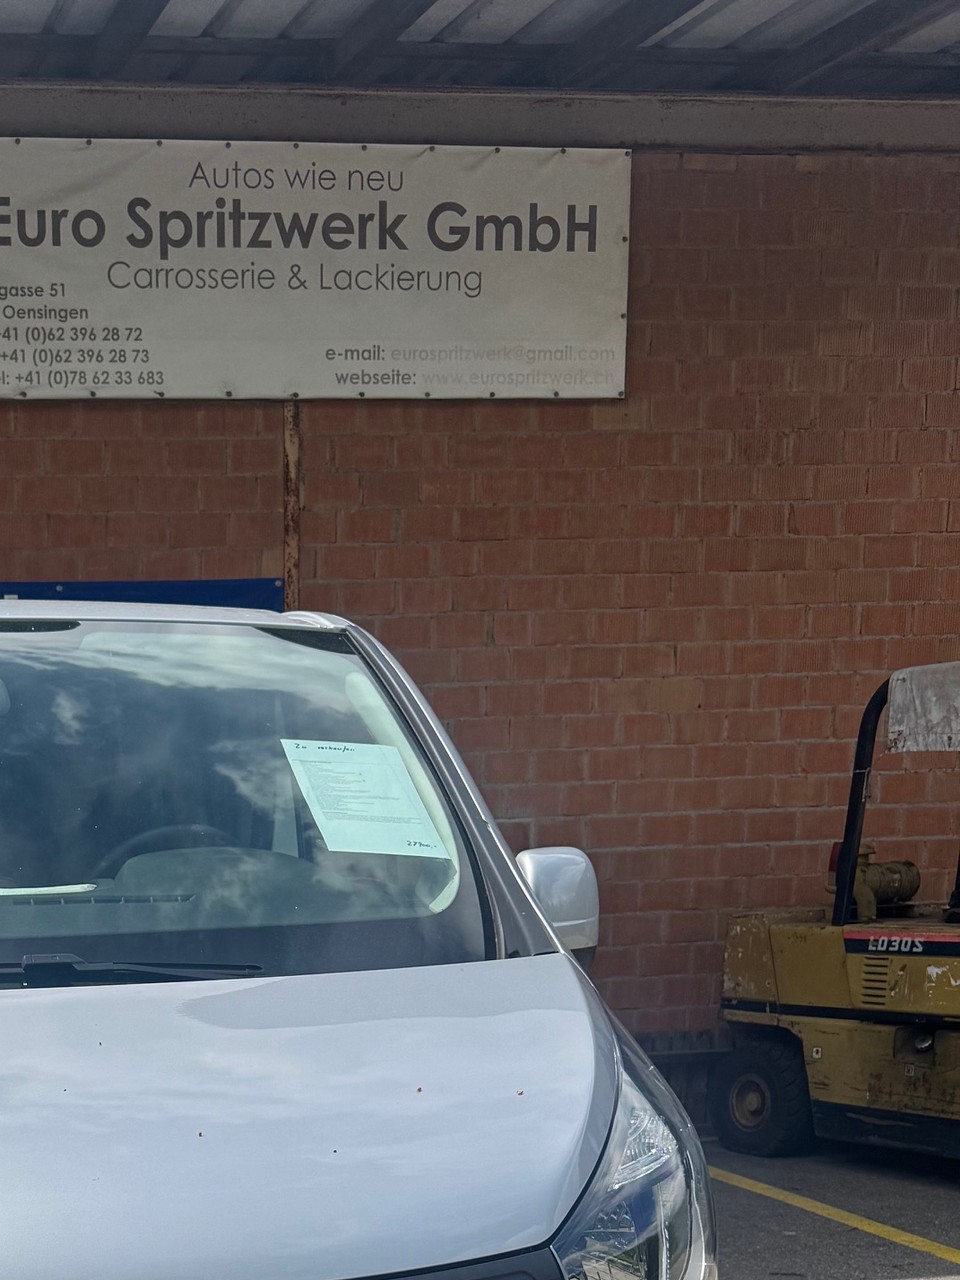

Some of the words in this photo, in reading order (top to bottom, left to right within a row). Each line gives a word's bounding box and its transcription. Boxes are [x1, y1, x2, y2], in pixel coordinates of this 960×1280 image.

[188, 161, 274, 189] Autos
[284, 162, 336, 190] wie
[348, 169, 404, 191] neu
[126, 196, 409, 260] Spritzwerk
[426, 202, 598, 252] GmbH
[107, 261, 275, 290] Carrosserie
[288, 264, 308, 290] &
[320, 263, 482, 298] Lackierung
[49, 283, 66, 297] 51
[3, 305, 89, 322] Oensingen
[26, 327, 65, 345] (0)62
[70, 327, 97, 341] 396
[102, 327, 120, 341] 28
[125, 328, 143, 341] 72
[0, 350, 26, 363] +41
[33, 349, 72, 366] (0)62
[77, 350, 104, 363] 396
[108, 350, 127, 363] 28
[132, 350, 149, 363] 73
[325, 345, 385, 361] e-mail:
[15, 372, 40, 385] +41
[48, 371, 87, 388] (0)78
[92, 372, 110, 385] 62
[115, 372, 132, 385] 33
[138, 372, 164, 385] 683
[335, 369, 417, 385] webseite:
